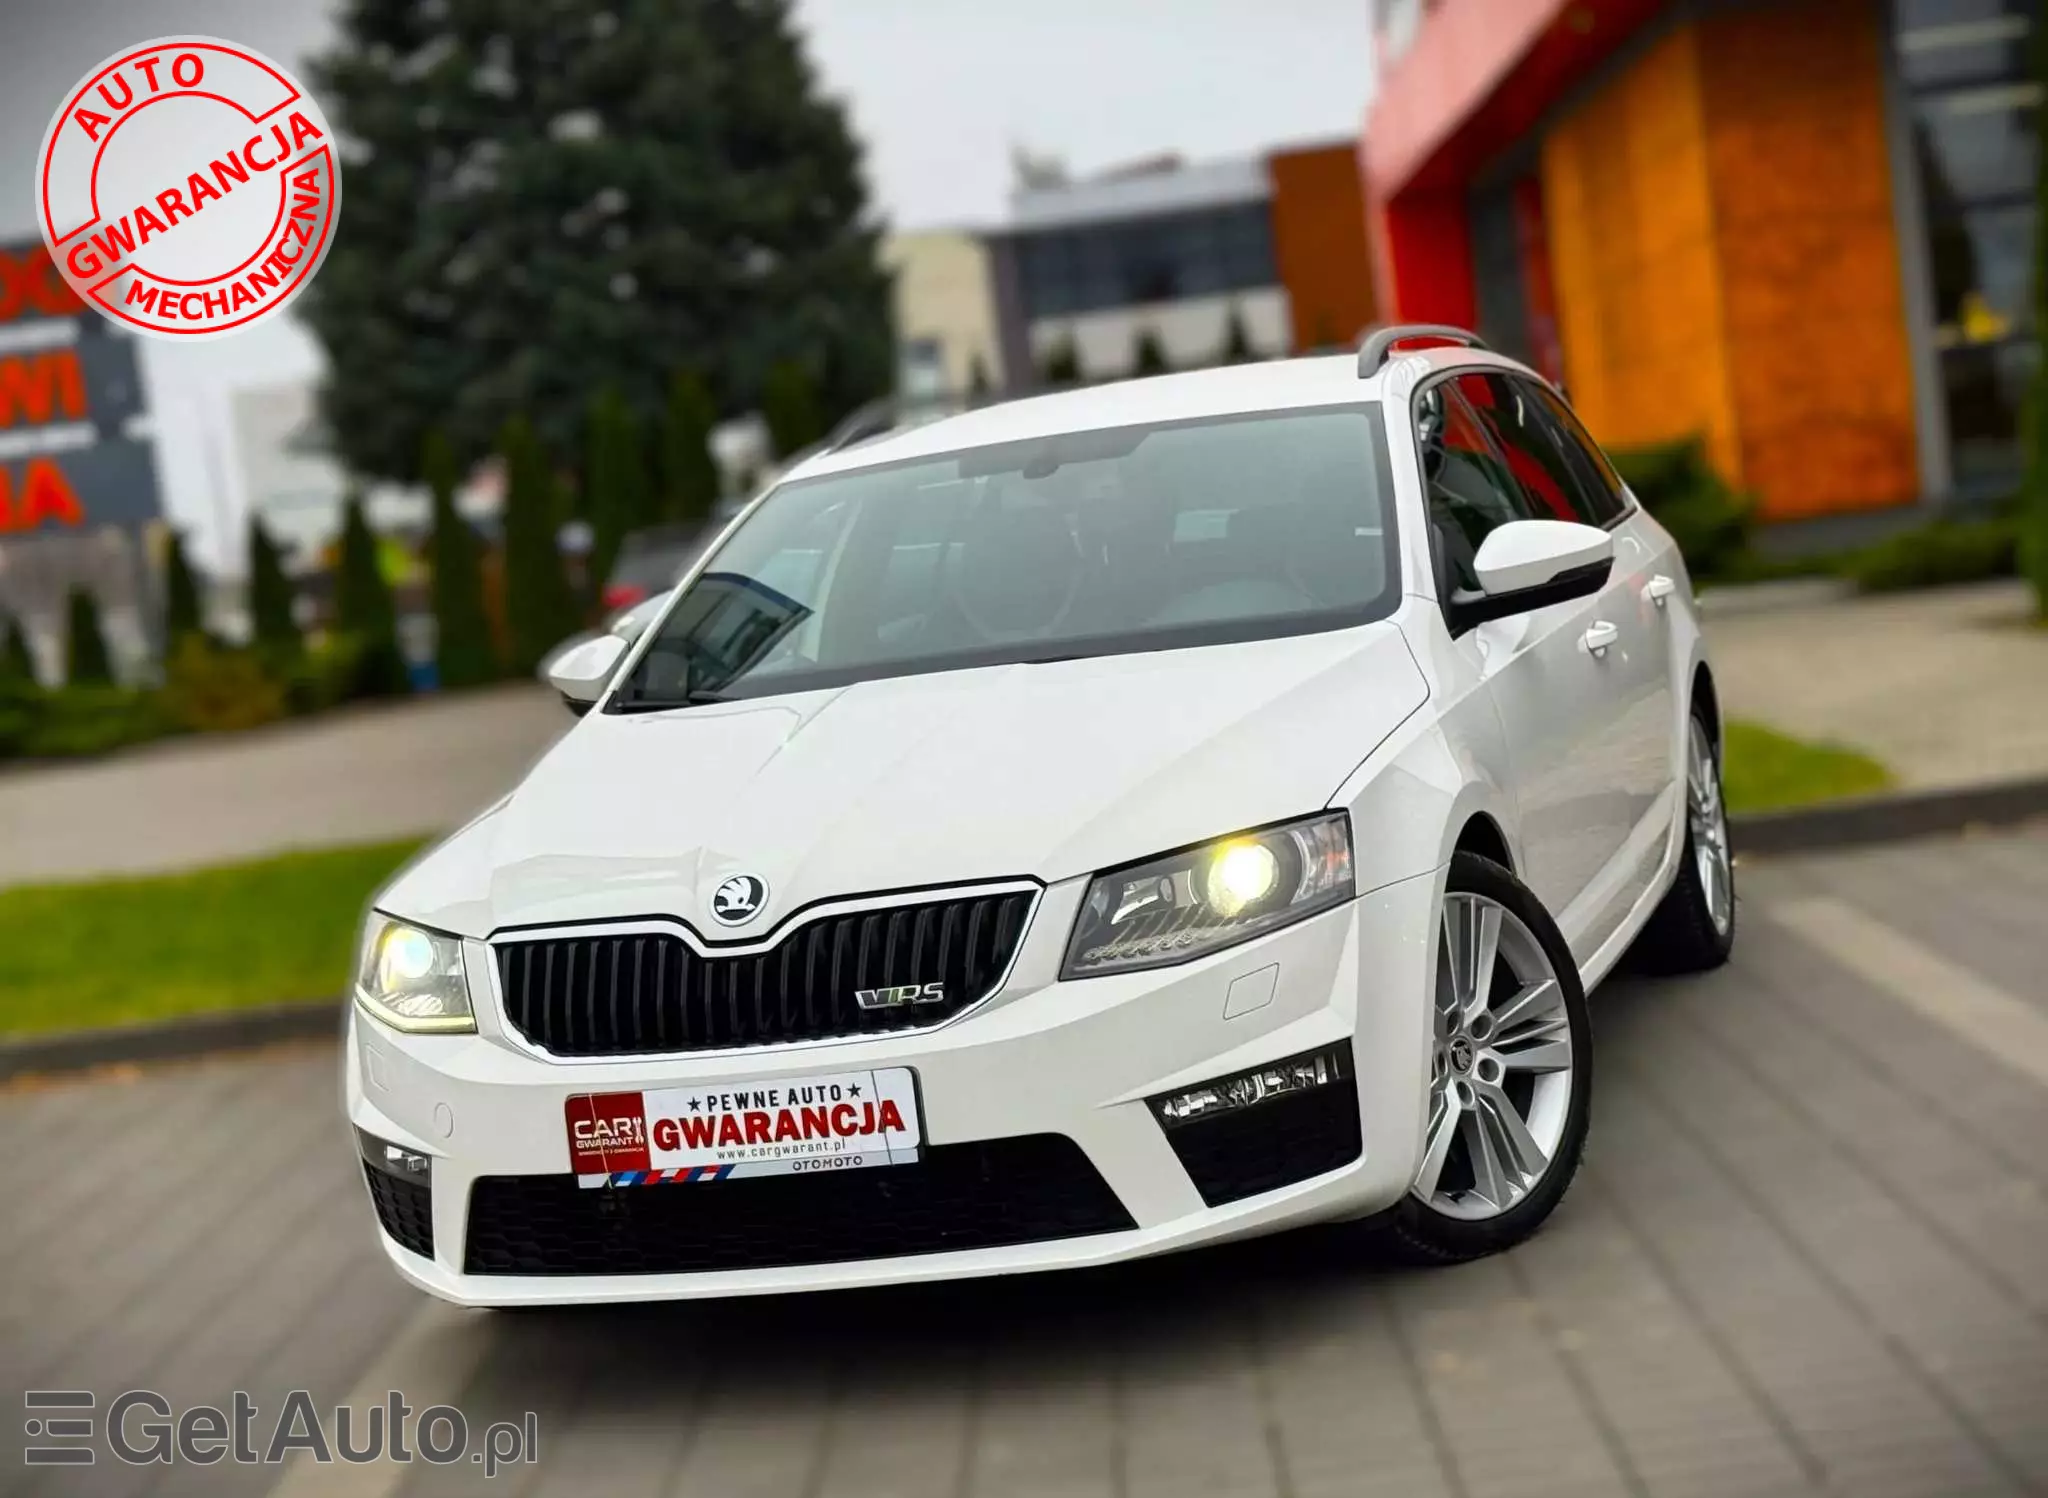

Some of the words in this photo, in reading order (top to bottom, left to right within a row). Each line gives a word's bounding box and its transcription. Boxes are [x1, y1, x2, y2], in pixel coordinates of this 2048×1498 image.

[707, 1090, 780, 1113] PEWNE
[788, 1084, 842, 1106] AUTO
[574, 1117, 633, 1139] CAR
[652, 1099, 906, 1152] GWARANCJA
[576, 1136, 634, 1149] GWARANT
[717, 1137, 847, 1160] www.cargwarant.pl
[792, 1155, 864, 1172] OTOMOTO
